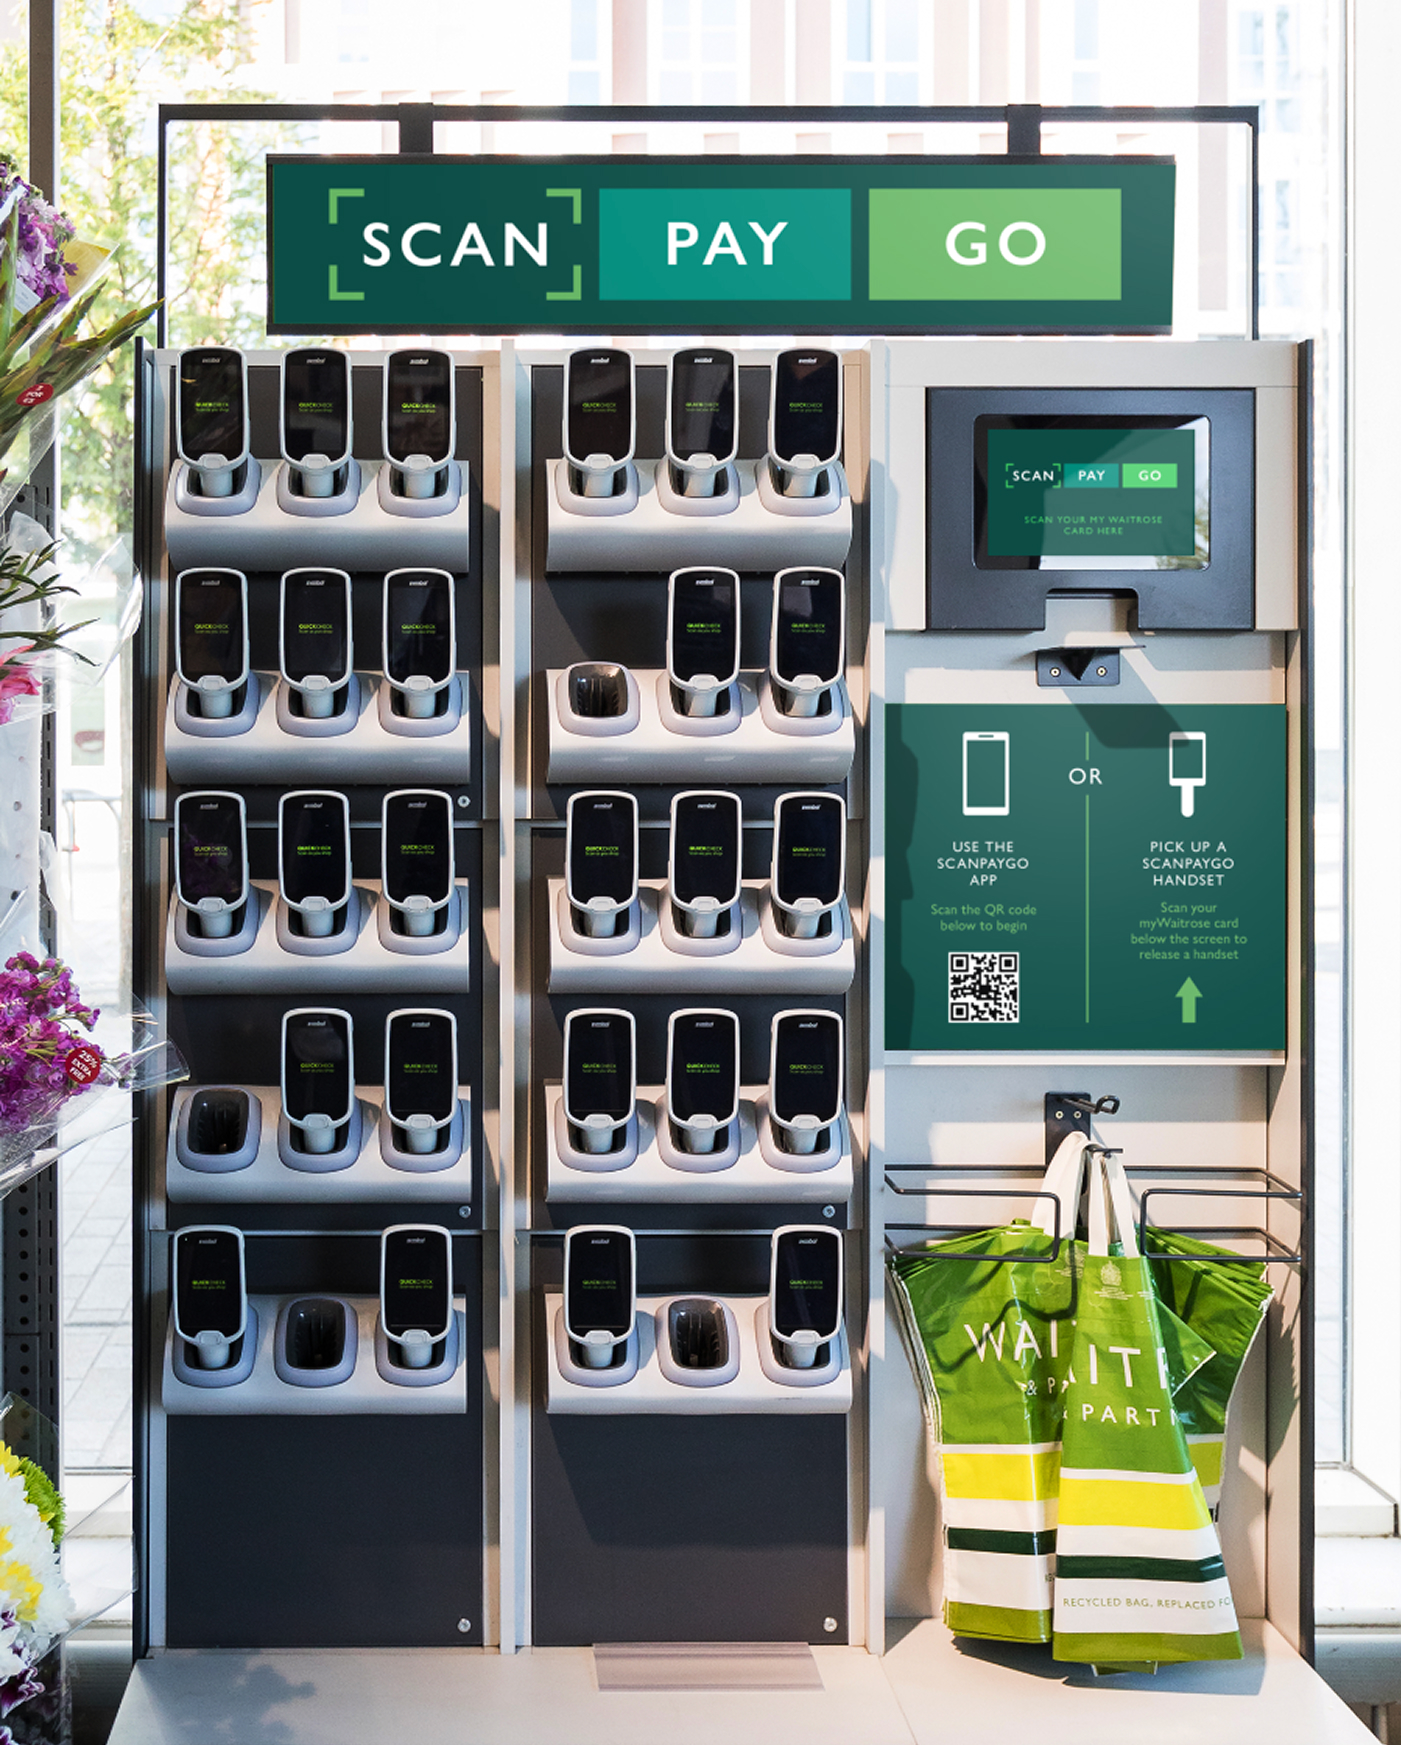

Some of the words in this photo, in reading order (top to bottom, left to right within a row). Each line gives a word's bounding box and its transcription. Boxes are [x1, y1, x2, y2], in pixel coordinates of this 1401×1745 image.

[364, 222, 547, 266] SCAN
[668, 222, 788, 265] PAY
[946, 222, 1046, 265] GO
[1013, 470, 1054, 482] SCAN
[1078, 470, 1106, 481] PAY
[1138, 469, 1162, 482] GO
[1023, 516, 1054, 524] SCAN
[1056, 516, 1086, 524] YOUR
[1089, 516, 1105, 524] MY
[1108, 516, 1162, 524] WAITROSE
[1063, 527, 1094, 535] CARD
[1097, 527, 1123, 535] HERE
[1068, 767, 1103, 785] OR
[952, 840, 979, 853] USE
[984, 840, 1014, 853] THE
[1150, 841, 1185, 853] PICK
[1190, 840, 1211, 853] UP
[1216, 841, 1227, 853] A
[937, 857, 1029, 870] SCANPAYGO
[1142, 857, 1235, 870] SCANPAYGO
[969, 874, 998, 886] APP
[1153, 874, 1225, 887] HANDSET
[930, 903, 958, 916] Scan
[961, 904, 981, 916] the
[984, 903, 1005, 917] QR
[1008, 904, 1037, 916] code
[1160, 901, 1188, 914] Scan
[1190, 904, 1218, 916] your
[940, 919, 977, 932] below
[979, 921, 993, 932] to
[996, 920, 1028, 935] begin
[1139, 917, 1211, 931] myWaitrose
[1213, 917, 1239, 929] card
[1130, 933, 1167, 945] below
[1169, 933, 1190, 945] the
[1192, 936, 1231, 945] screen
[1233, 934, 1248, 945] to
[1139, 948, 1181, 960] release
[1183, 952, 1191, 960] a
[1193, 948, 1239, 960] handset
[79, 1050, 98, 1068] 25%
[69, 1066, 86, 1081] FREE
[71, 1058, 91, 1077] EXTRA
[964, 1319, 1077, 1362] WAI
[1026, 1379, 1038, 1396] &
[1063, 1597, 1122, 1608] RECYCLED
[1157, 1598, 1215, 1610] REPLACED
[1218, 1596, 1234, 1607] FO
